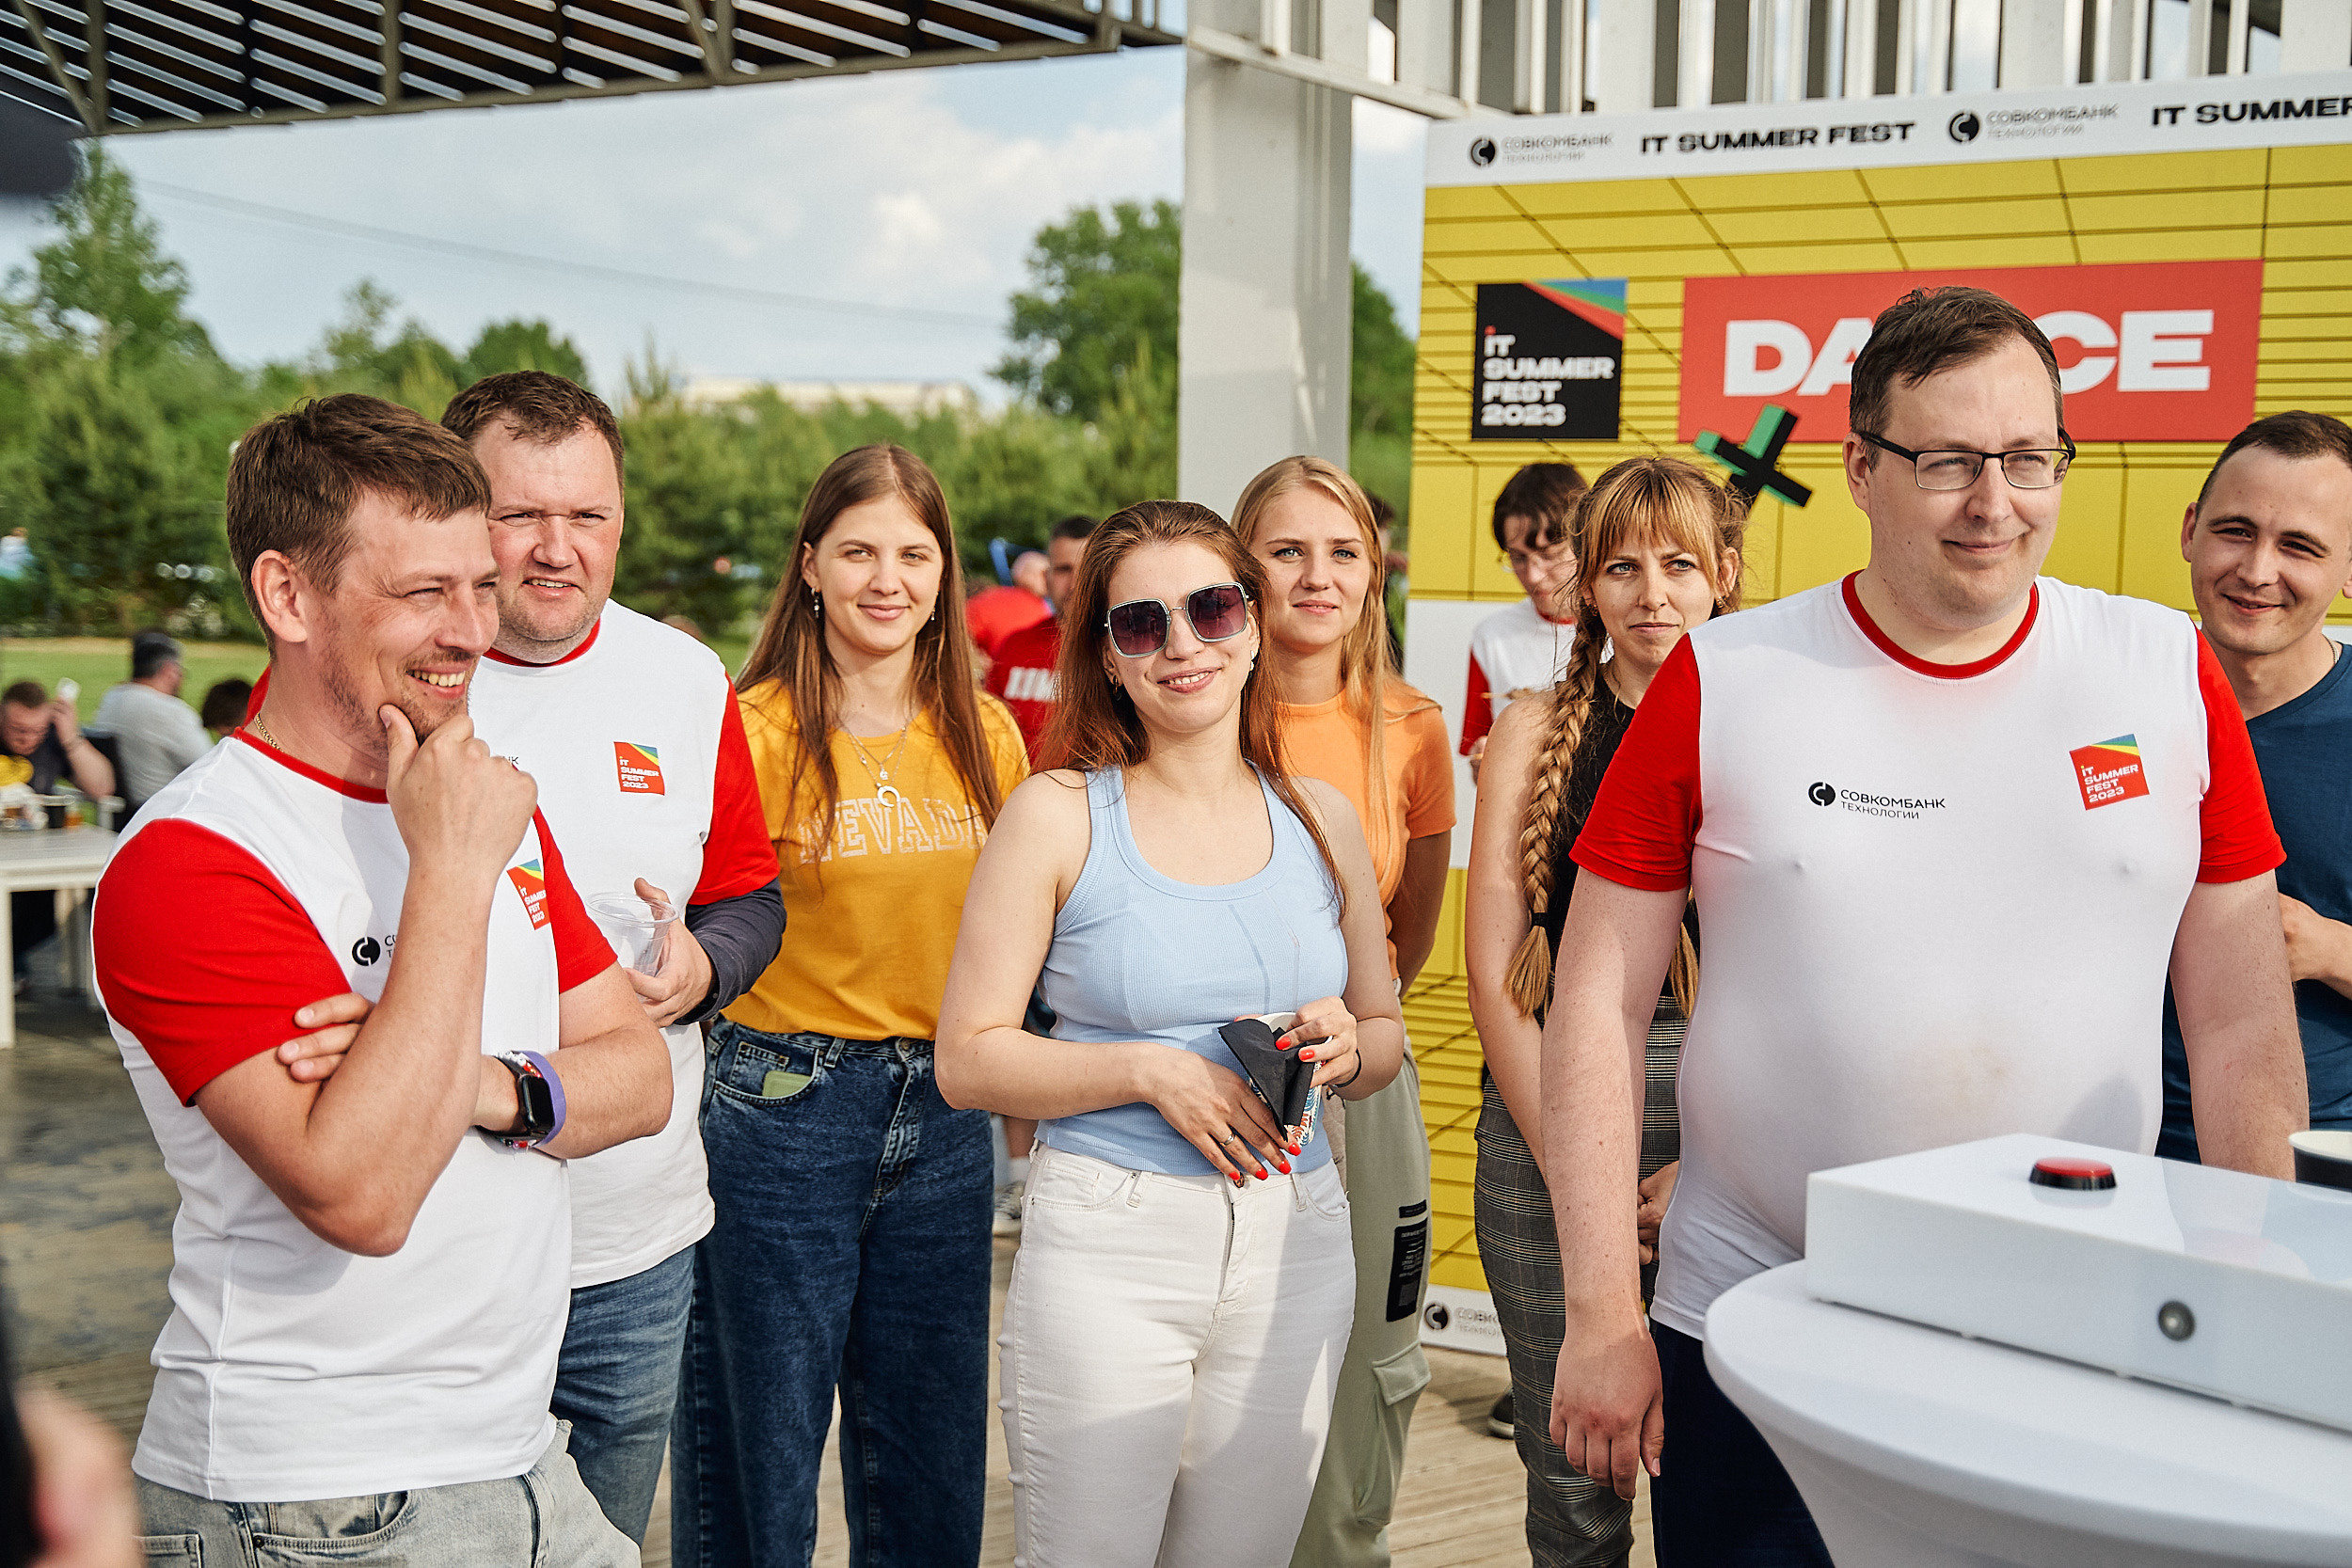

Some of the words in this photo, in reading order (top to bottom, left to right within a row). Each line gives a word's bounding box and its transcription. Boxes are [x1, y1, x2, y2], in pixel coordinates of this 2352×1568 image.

[2153, 106, 2185, 125] IT
[1642, 136, 1668, 153] IT
[1678, 128, 1818, 151] SUMMER
[1829, 121, 1915, 144] FEST
[1724, 309, 2215, 396] DACE
[1483, 356, 1615, 380] SUMMER
[1482, 380, 1563, 404] FEST
[1481, 403, 1566, 427] 2023
[620, 767, 660, 777] SUMMER
[621, 773, 645, 782] FEST
[2084, 764, 2138, 785] SUMMER
[2086, 778, 2119, 795] FEST
[2089, 786, 2125, 803] 2023
[1840, 789, 1946, 809] СОВКОМБАНК
[1841, 801, 1919, 819] ТЕХНОЛОГИИ
